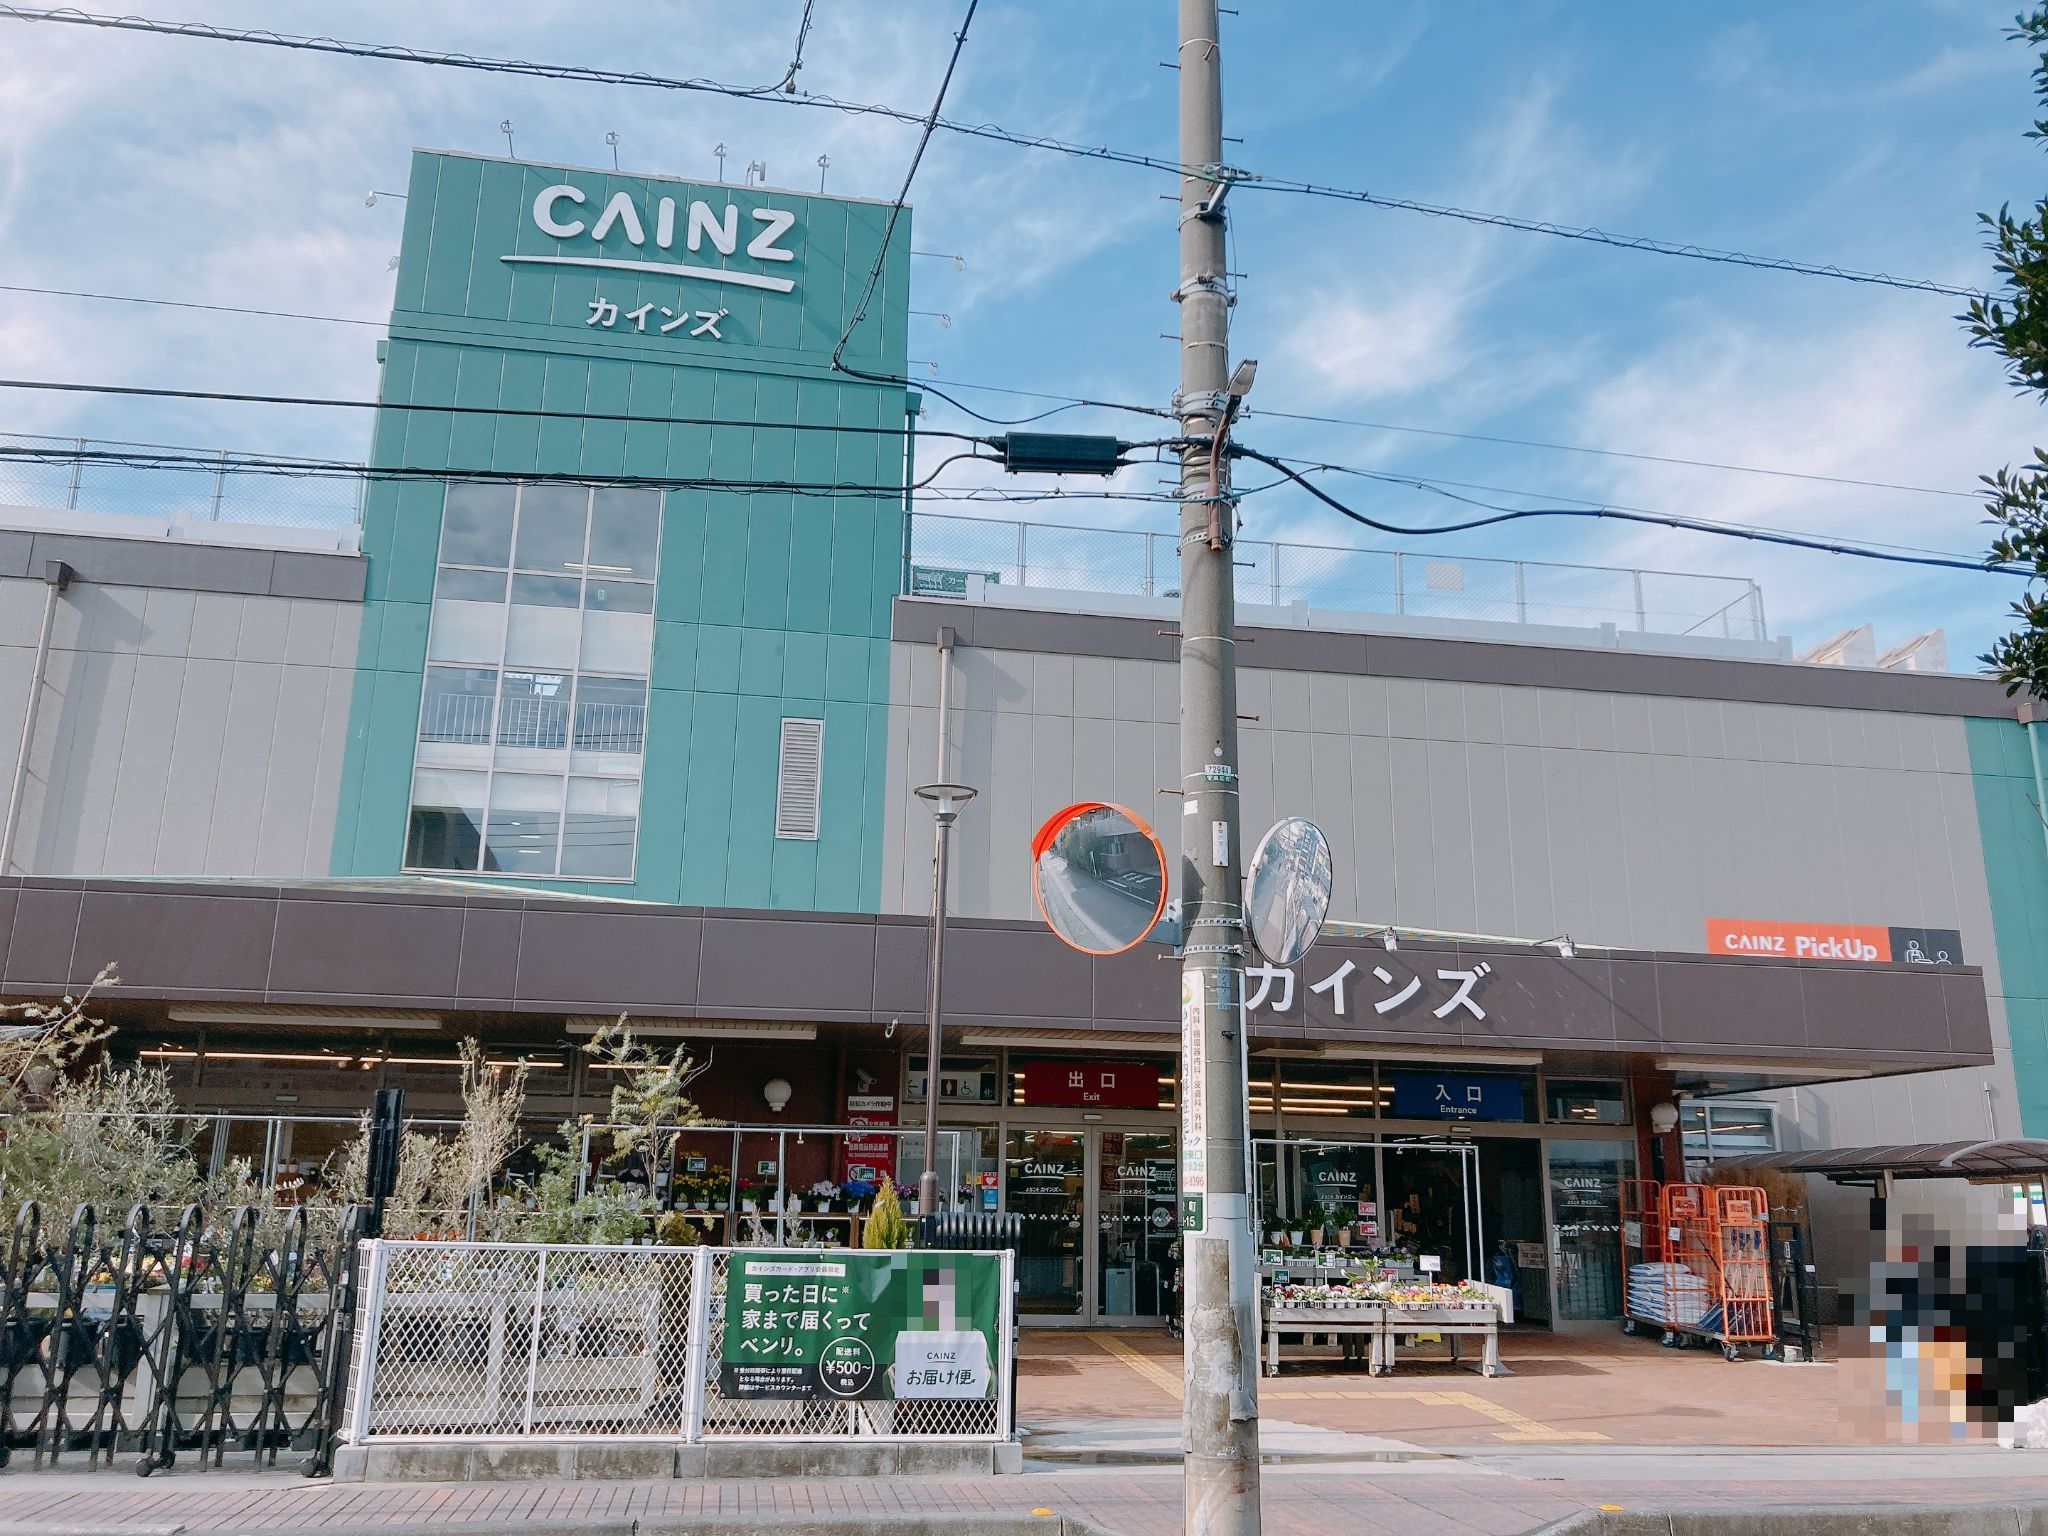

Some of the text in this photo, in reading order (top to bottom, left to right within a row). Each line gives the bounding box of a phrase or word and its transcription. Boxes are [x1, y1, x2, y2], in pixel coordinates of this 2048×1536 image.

[533, 184, 795, 262] CAINZ
[585, 297, 729, 340] カインズ
[1724, 933, 1878, 961] CAINZ PickUp
[1245, 959, 1492, 1021] カインズ
[1068, 1071, 1116, 1089] 出口
[1083, 1092, 1100, 1101] Exit
[1434, 1084, 1483, 1102] 入口
[1439, 1104, 1478, 1115] Entrance
[1024, 1163, 1064, 1174] CAINZ
[1117, 1166, 1157, 1177] CAINZ
[1318, 1172, 1357, 1182] CAINZ
[1564, 1178, 1602, 1188] CAINZ
[741, 1308, 871, 1331] 家まで届くって
[740, 1337, 803, 1357] ベンリ。
[835, 1347, 861, 1356] 配送料
[927, 1352, 957, 1360] CAINZ
[840, 1378, 855, 1387] 税込
[906, 1369, 977, 1386] お届け便
